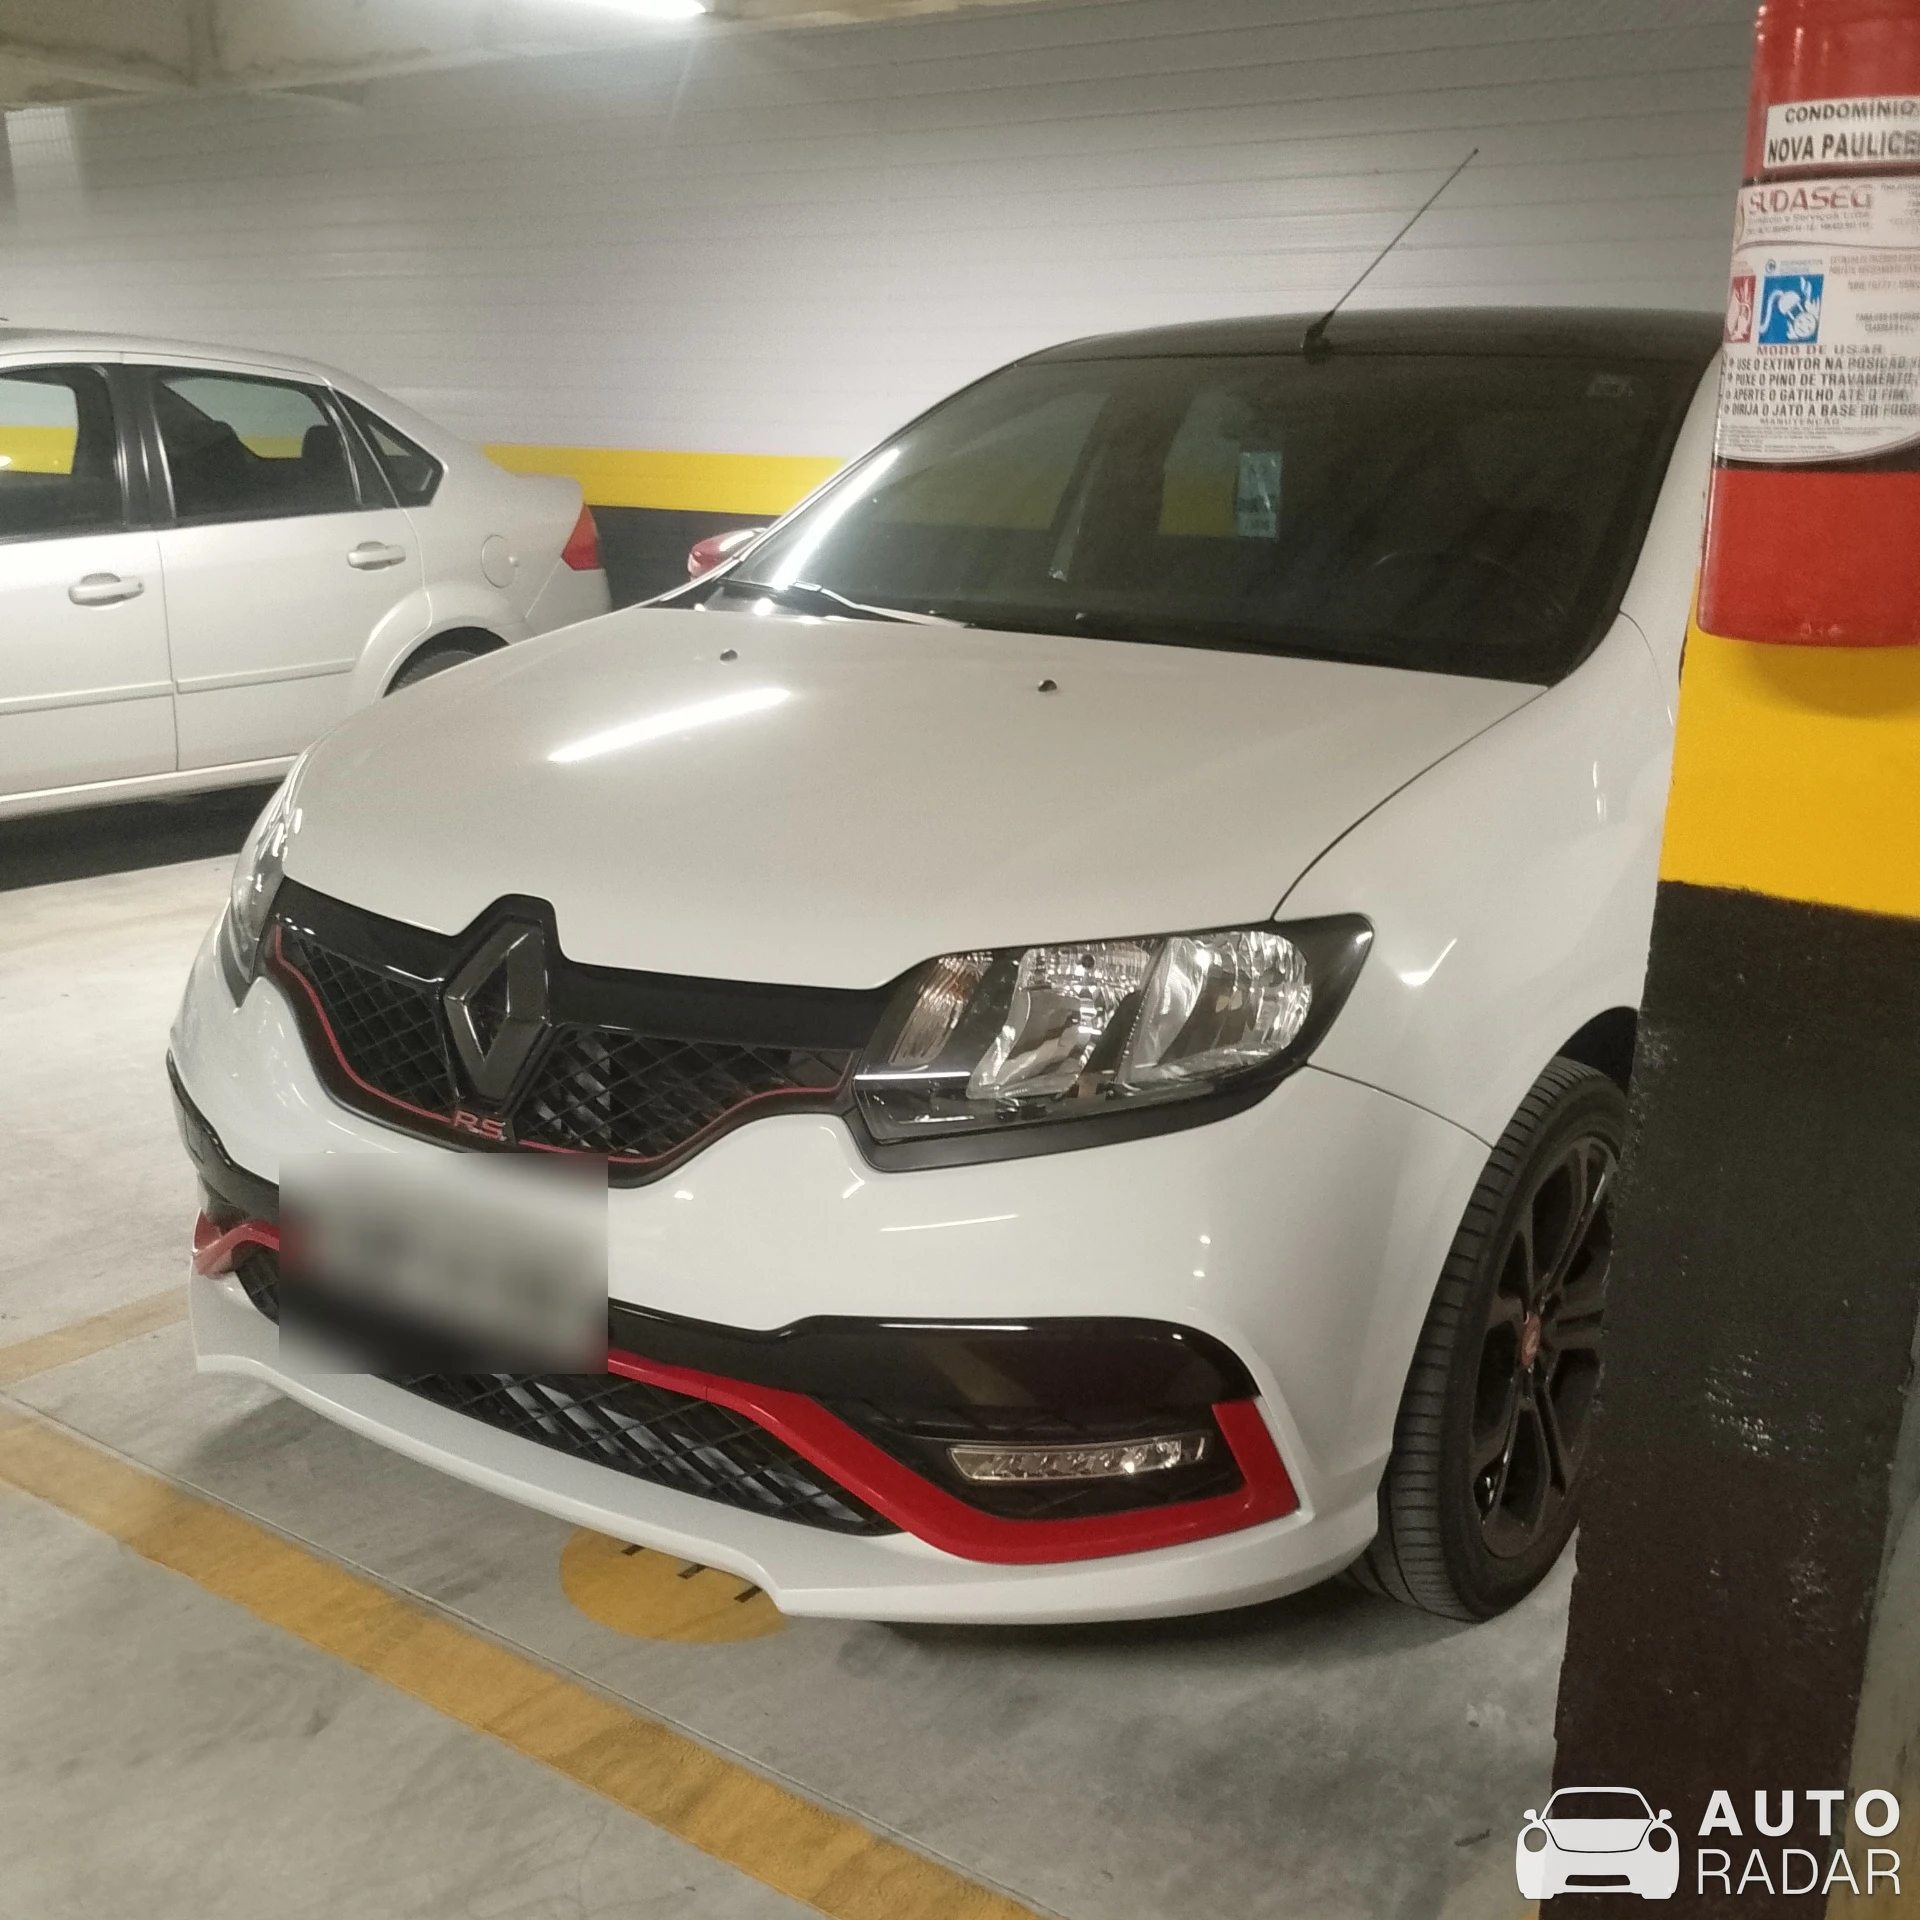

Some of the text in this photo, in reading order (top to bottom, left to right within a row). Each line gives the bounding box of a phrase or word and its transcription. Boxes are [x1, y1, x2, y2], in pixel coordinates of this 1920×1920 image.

[1785, 100, 1915, 123] CONDOMINIO
[1768, 136, 1814, 163] NOVA
[1756, 344, 1882, 356] MODO DE USAR
[1737, 358, 1751, 371] USE
[1754, 358, 1760, 371] O
[1763, 358, 1820, 371] EXTINTOR
[1825, 357, 1842, 370] NA
[1735, 372, 1756, 386] PUXE
[1759, 373, 1766, 386] O
[1769, 374, 1795, 386] PINO
[1801, 373, 1816, 386] DE
[1734, 387, 1765, 401] APERTE
[1769, 389, 1776, 401] O
[1780, 388, 1834, 401] GATILHO
[1868, 389, 1876, 401] O
[1732, 403, 1759, 416] DIRIJA
[1762, 404, 1769, 416] O
[1772, 404, 1803, 416] JATO
[1821, 403, 1856, 417] BASE
[453, 1110, 507, 1141] RS
